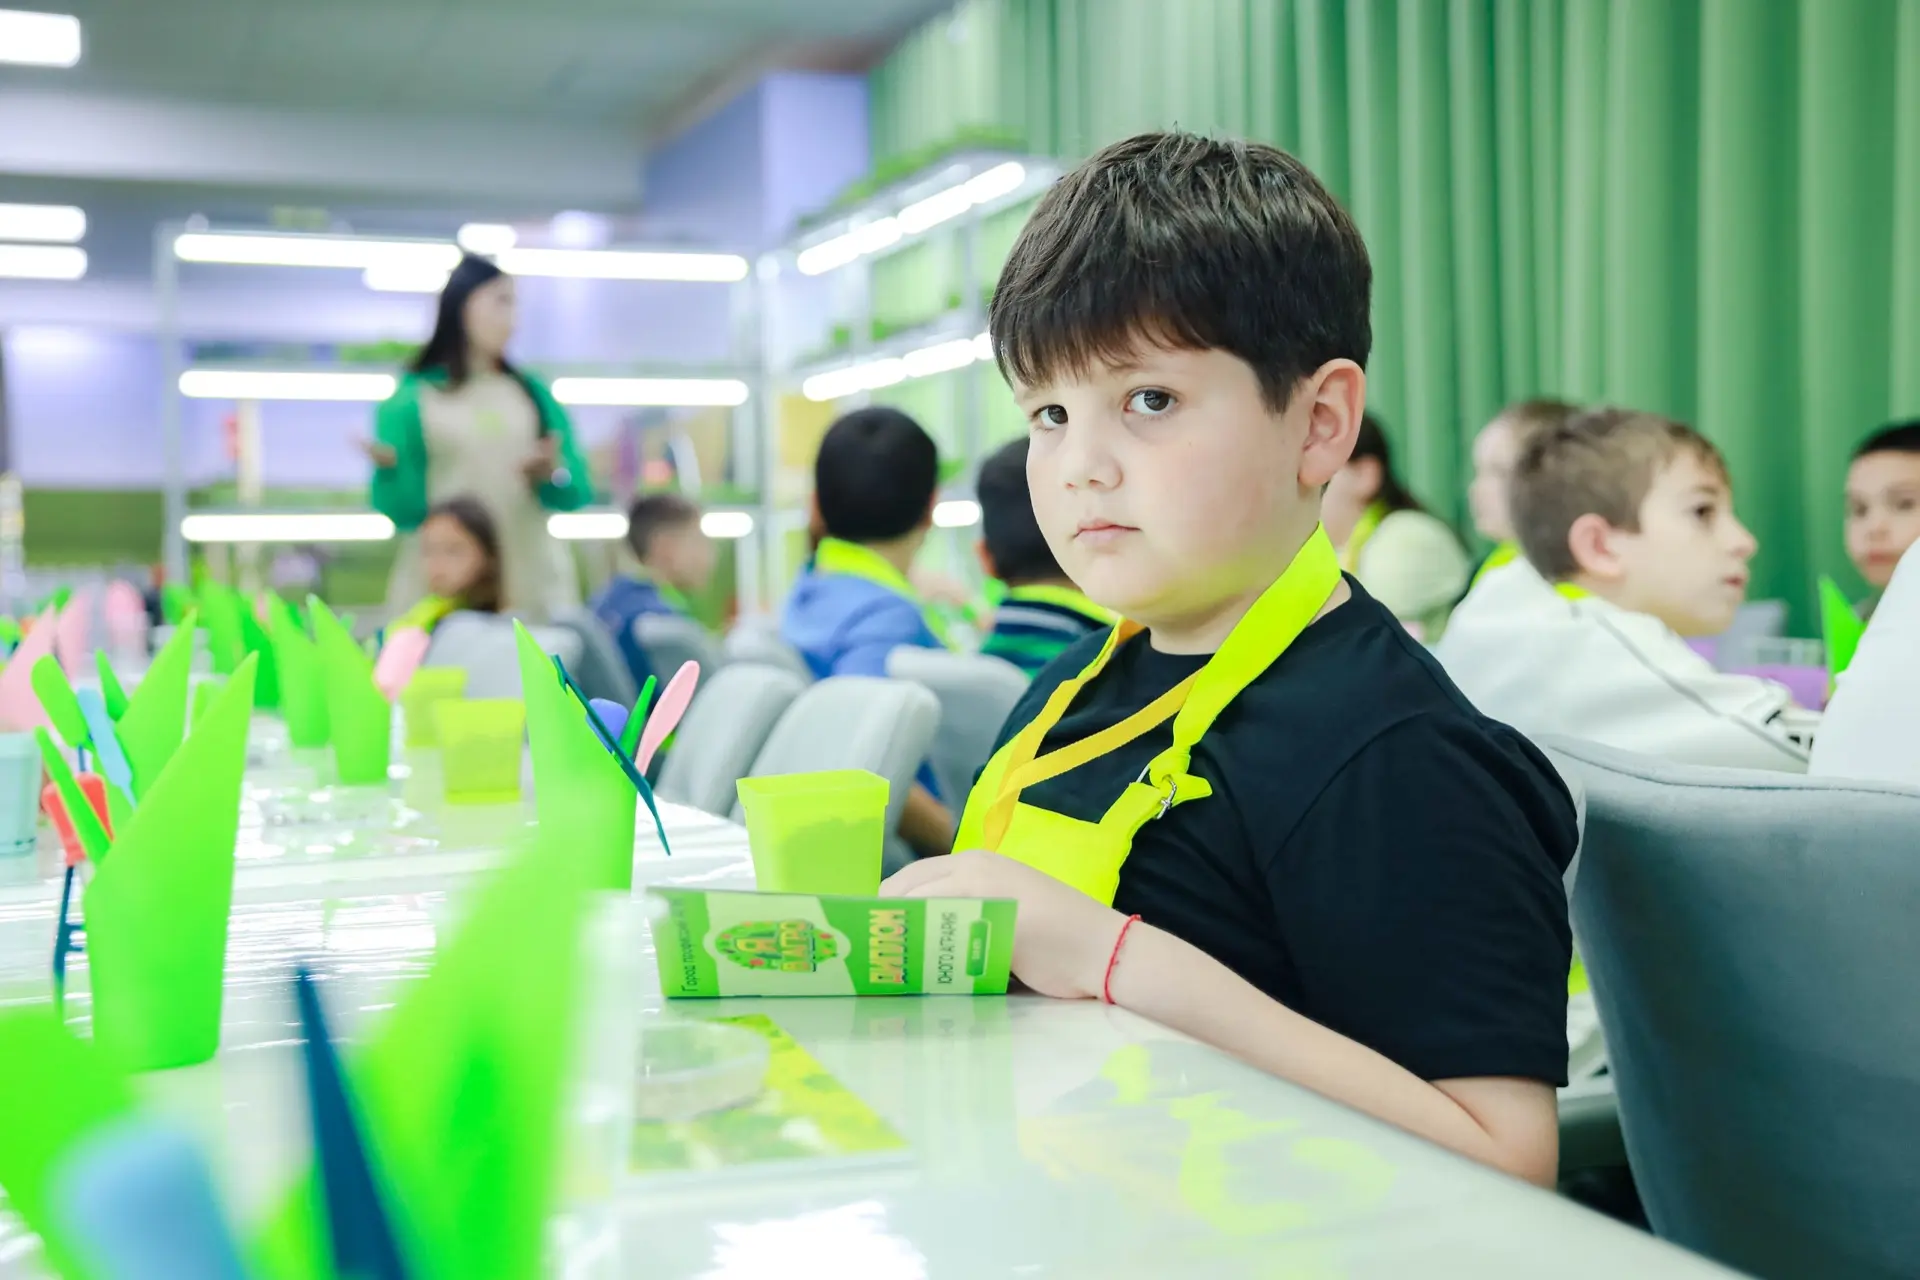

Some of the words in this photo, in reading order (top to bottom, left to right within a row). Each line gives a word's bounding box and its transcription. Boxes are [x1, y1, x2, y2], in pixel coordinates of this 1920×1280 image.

[736, 937, 777, 953] Я
[778, 920, 813, 958] АГРО
[869, 908, 907, 984] ДИПЛОМ
[681, 965, 700, 992] Город
[937, 953, 954, 984] ЮНОГО
